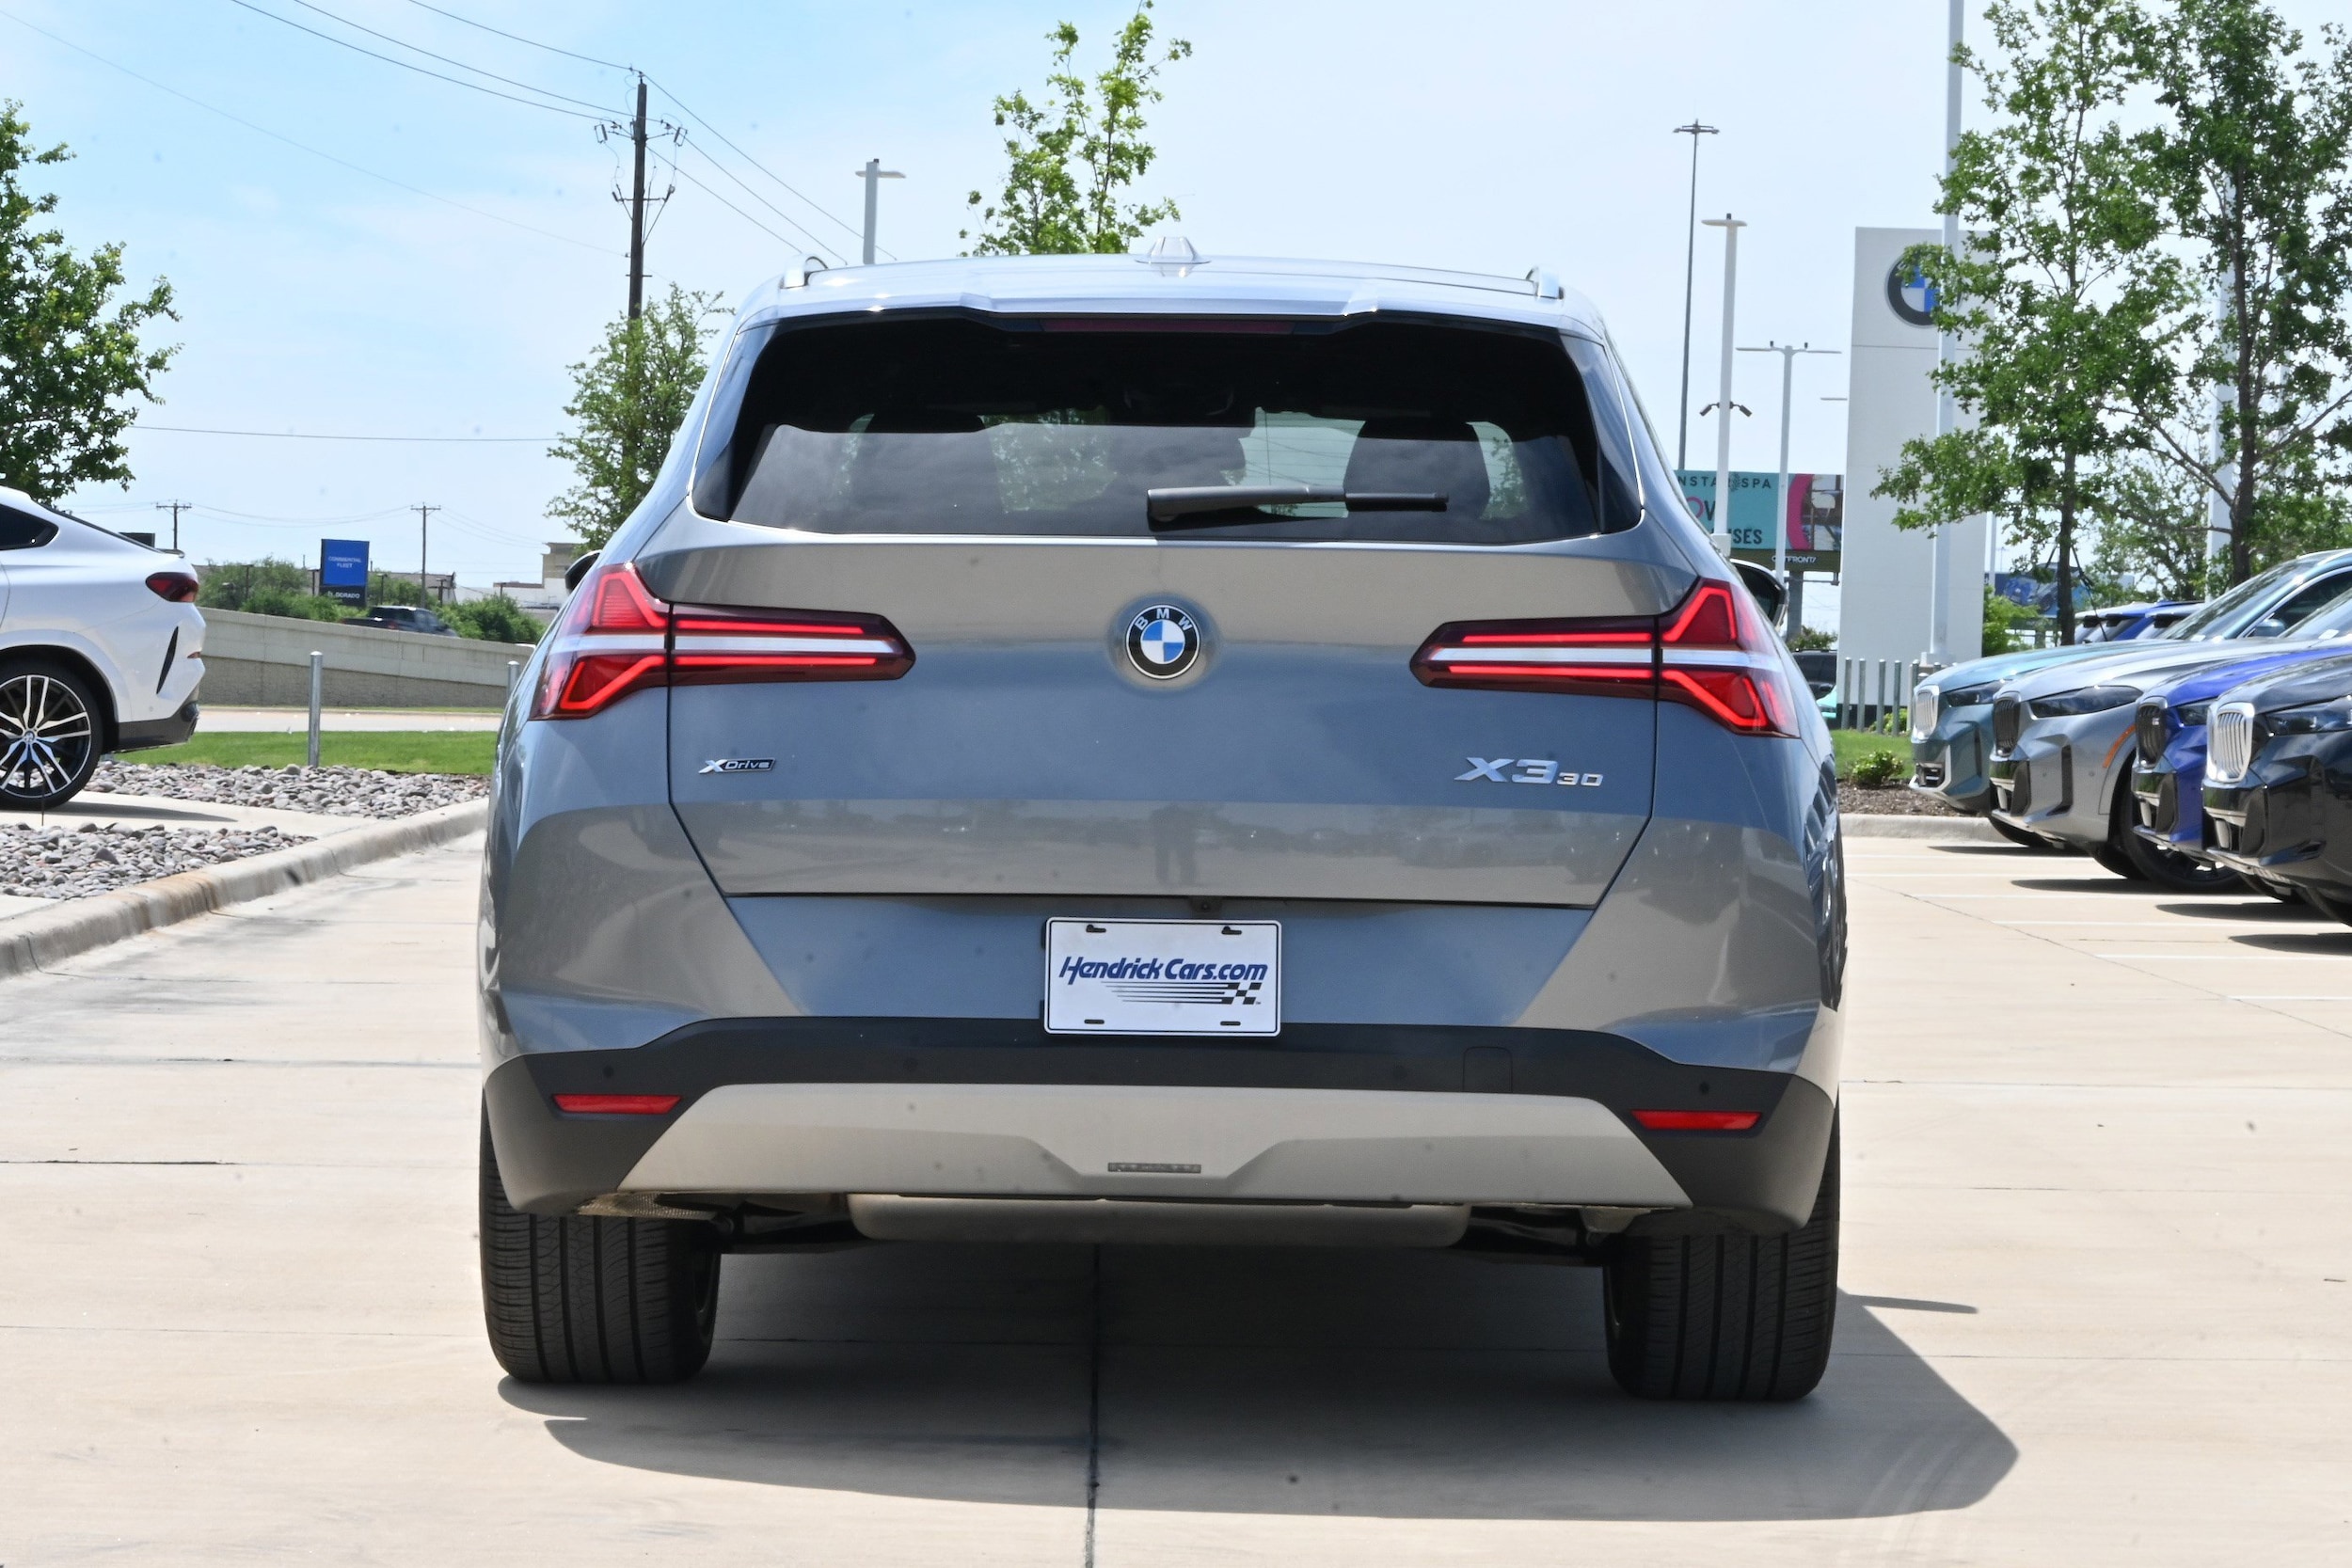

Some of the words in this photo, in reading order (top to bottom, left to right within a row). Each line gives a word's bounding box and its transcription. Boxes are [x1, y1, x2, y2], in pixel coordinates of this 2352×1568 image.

[1677, 475, 1731, 488] NSTA
[1741, 478, 1772, 489] SPA
[1134, 608, 1193, 631] BMW
